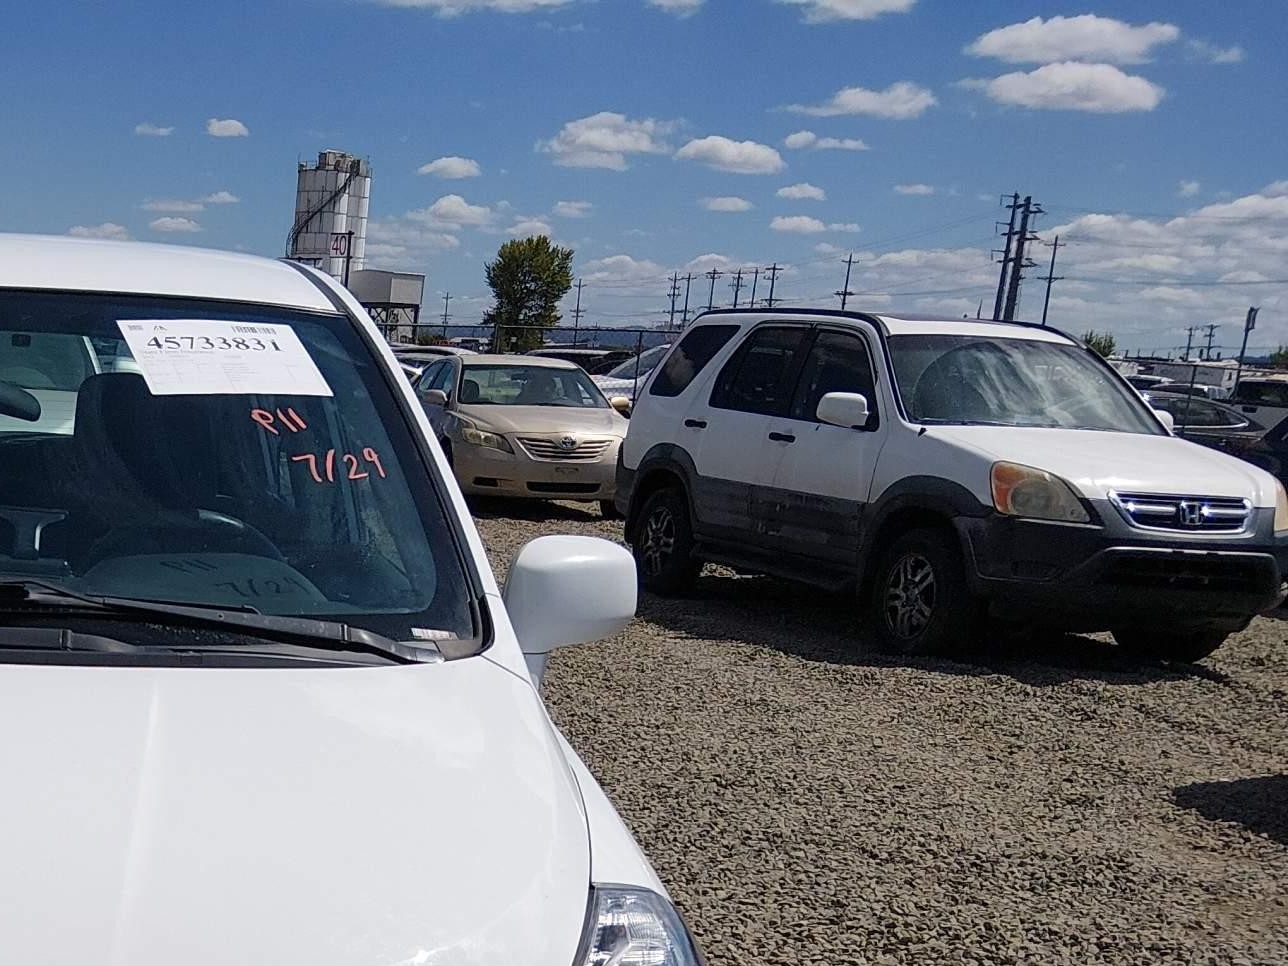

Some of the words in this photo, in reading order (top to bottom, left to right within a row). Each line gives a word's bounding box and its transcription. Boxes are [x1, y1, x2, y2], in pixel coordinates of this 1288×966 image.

[331, 235, 347, 256] 40
[147, 335, 283, 352] 45733831
[292, 447, 386, 482] 7/29
